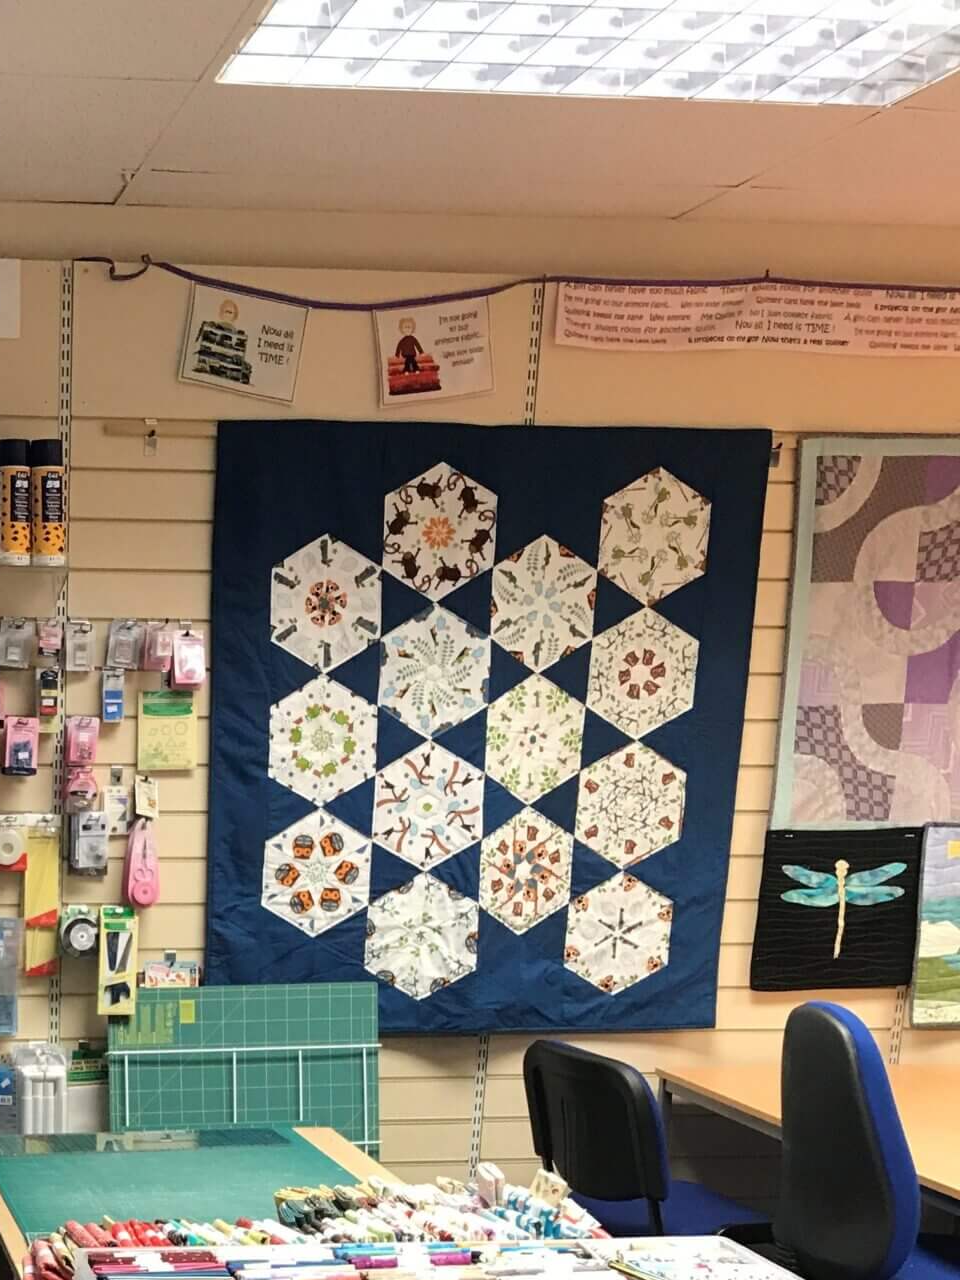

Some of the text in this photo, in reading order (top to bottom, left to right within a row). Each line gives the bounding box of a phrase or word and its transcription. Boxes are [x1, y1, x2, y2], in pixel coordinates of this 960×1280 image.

[261, 324, 282, 338] Now
[263, 339, 284, 351] need
[286, 342, 294, 352] is
